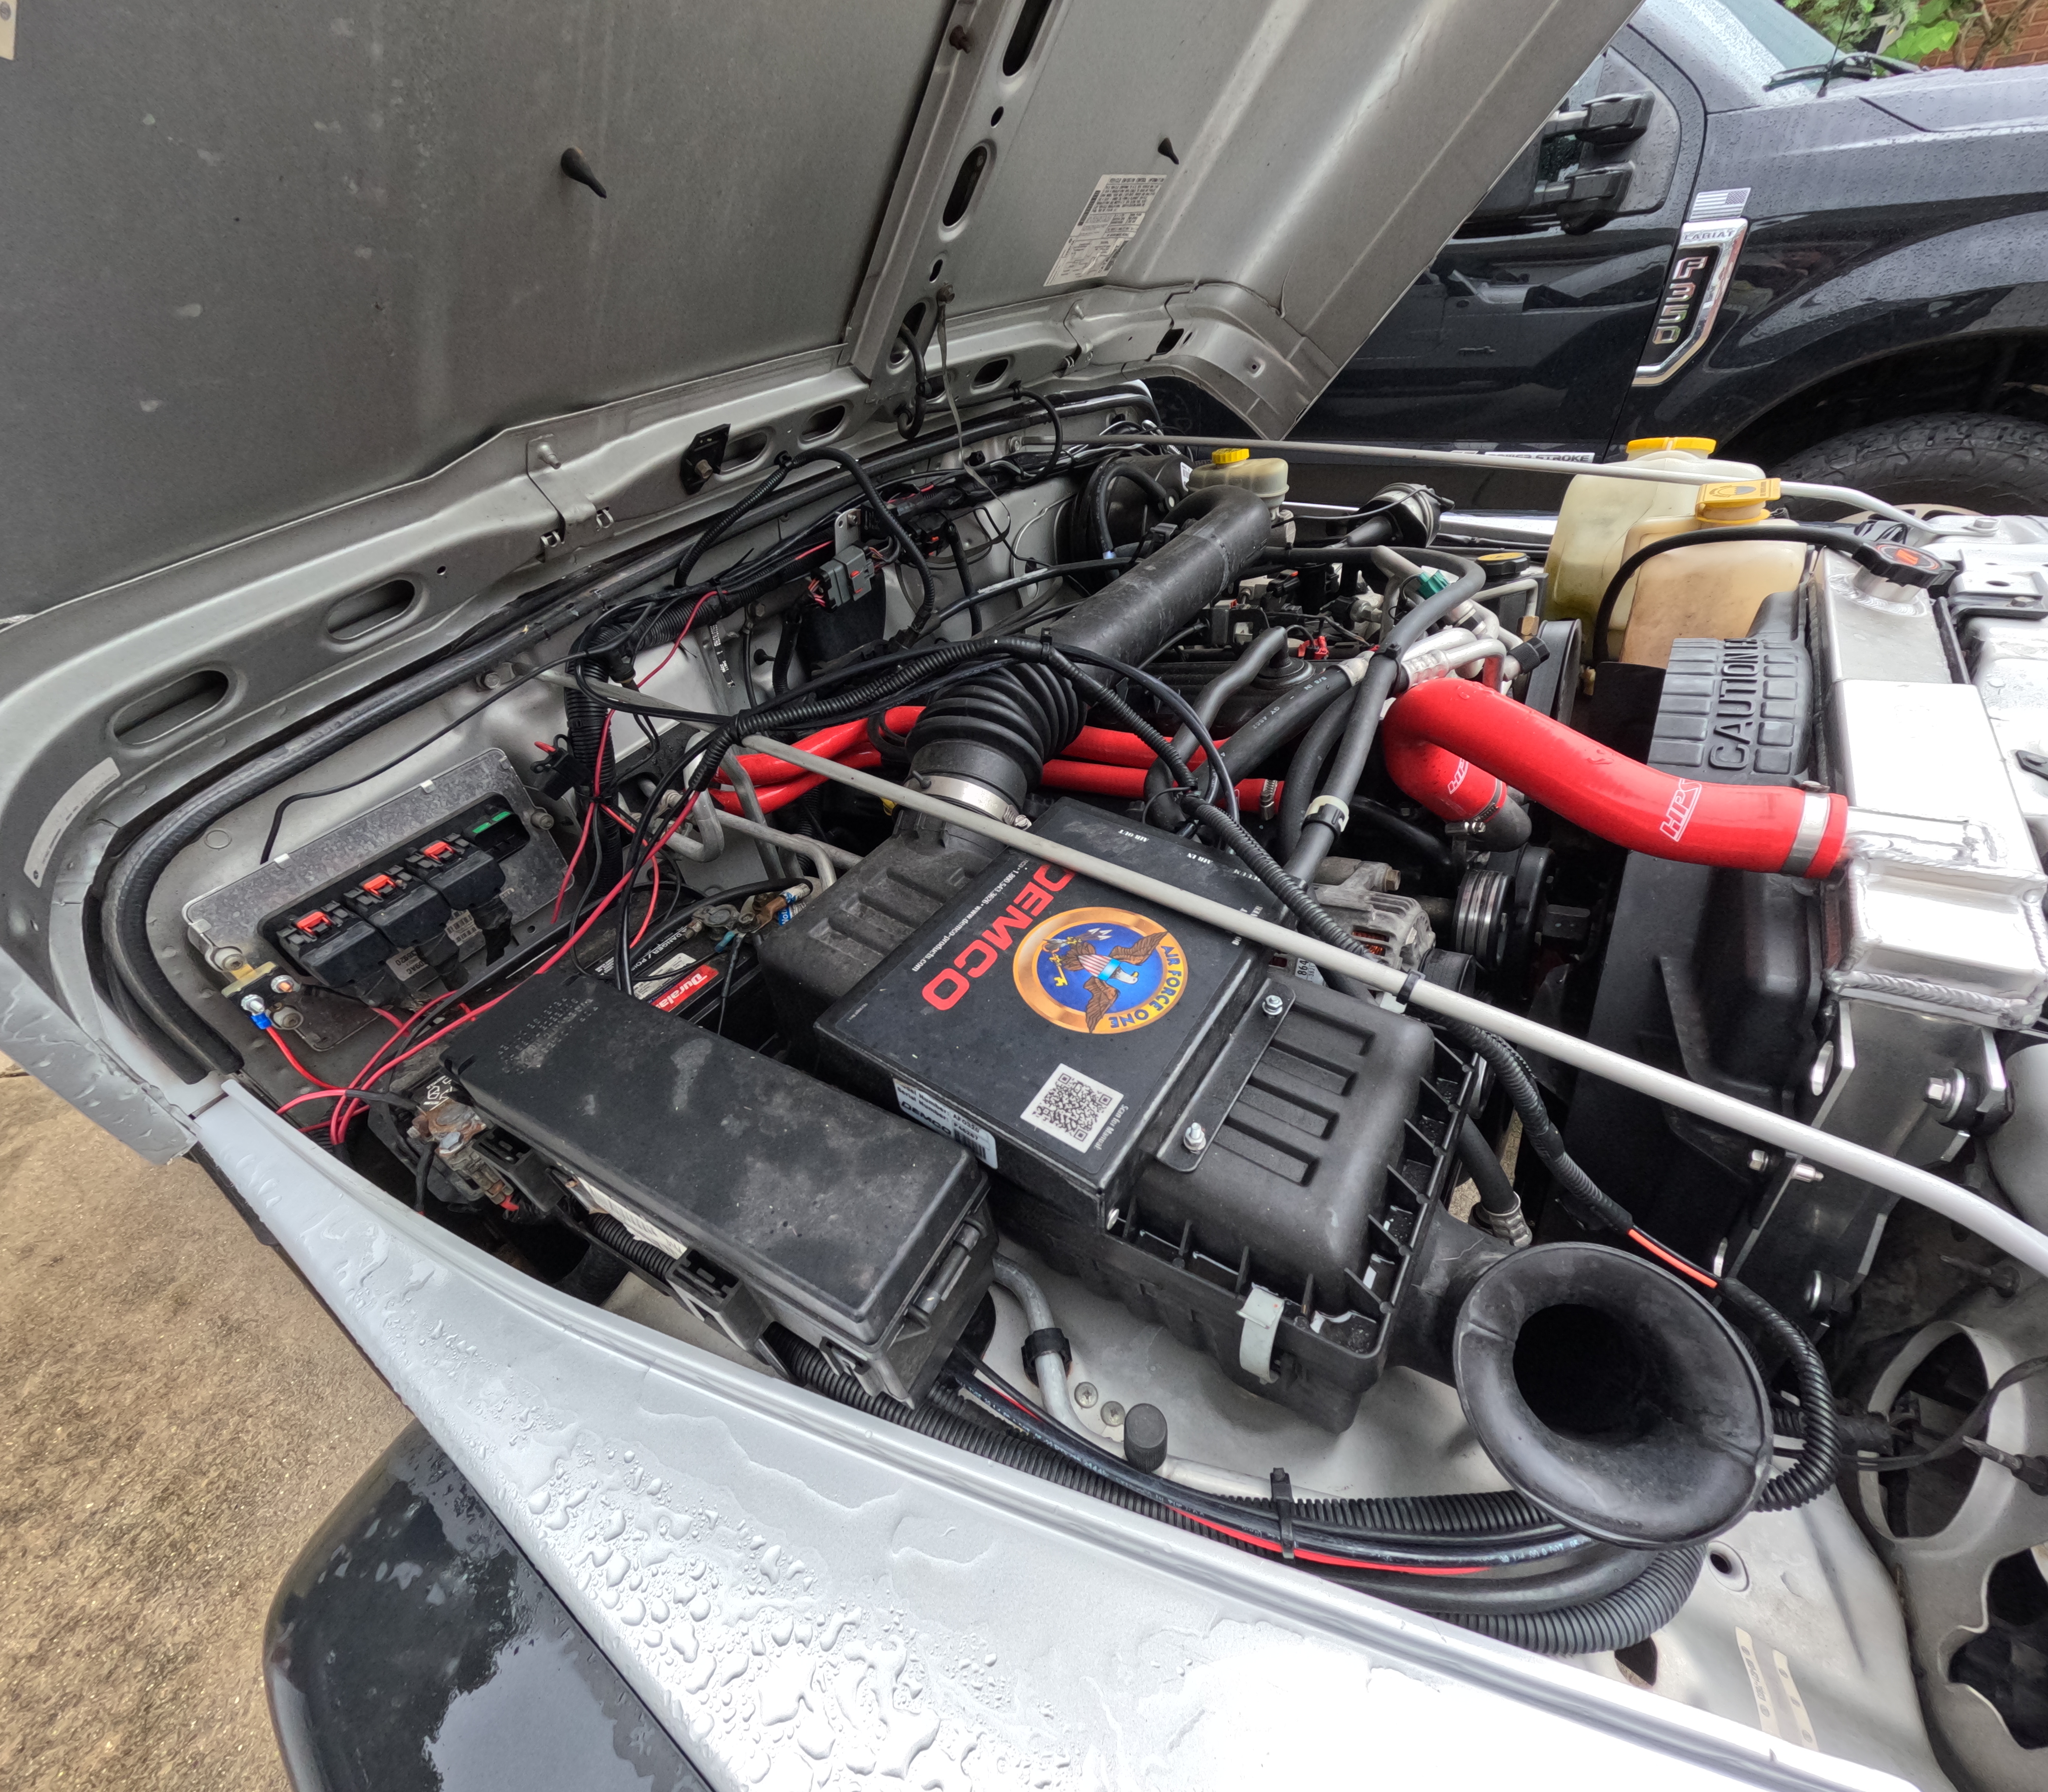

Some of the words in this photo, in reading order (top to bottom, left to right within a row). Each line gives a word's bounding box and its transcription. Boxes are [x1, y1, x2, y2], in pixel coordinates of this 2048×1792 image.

[1683, 230, 1734, 241] LARIAT
[1270, 706, 1280, 715] GY
[1708, 651, 1759, 771] CAUTION
[1118, 829, 1134, 838] OUT
[1135, 834, 1149, 842] AIR
[1197, 856, 1213, 864] AIR
[981, 869, 1020, 905] 1.800.543.3626
[654, 931, 684, 955] DANGER
[911, 905, 982, 972] www.demco-products.com
[922, 863, 1076, 1011] DEMCO
[1231, 936, 1242, 946] DO
[1160, 945, 1181, 966] AIR
[631, 958, 647, 972] POIS
[1297, 960, 1309, 976] 864
[655, 973, 707, 1009] Durala
[1149, 970, 1182, 1011] FORCE
[1108, 1009, 1149, 1028] ONE
[897, 1086, 917, 1102] Serial
[901, 1101, 952, 1135] DEMCO
[1114, 1104, 1129, 1119] Scan
[1109, 1117, 1120, 1127] for
